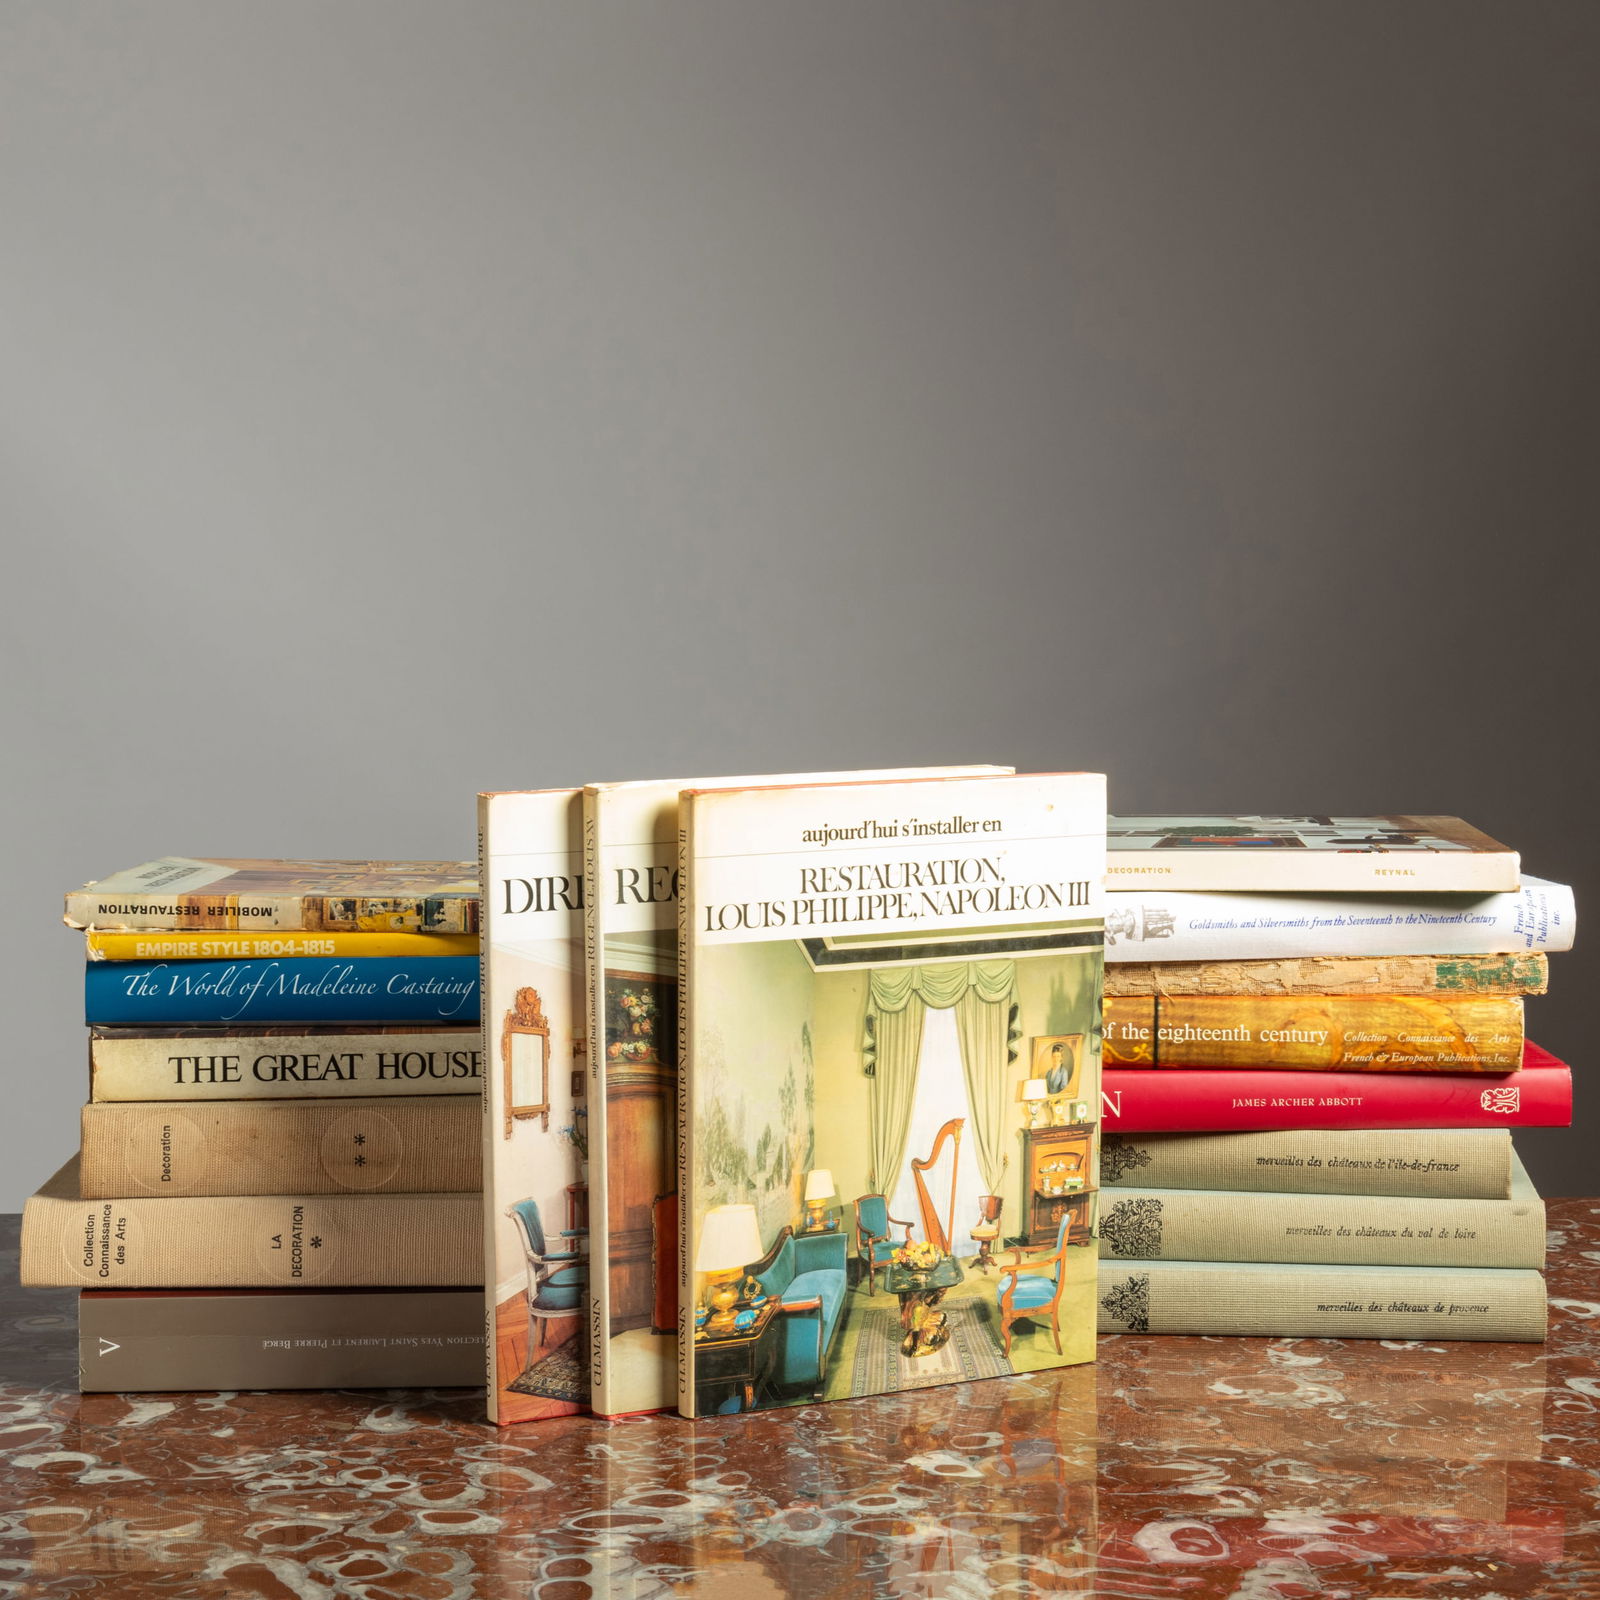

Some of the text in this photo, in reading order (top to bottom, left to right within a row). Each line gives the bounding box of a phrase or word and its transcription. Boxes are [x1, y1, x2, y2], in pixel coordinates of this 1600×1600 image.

[802, 816, 1003, 847] aujourd'hui s'installer en
[586, 838, 594, 883] LOUIS
[799, 857, 1006, 894] RESTAURATION,
[98, 903, 273, 917] MOBILIER RESTAURATION
[704, 902, 786, 932] LOUIS
[1068, 881, 1091, 907] III
[1188, 913, 1498, 929] Goldsmiths and Silversmiths from the Seventeenth to the Nineteenth Century
[1513, 904, 1523, 934] French
[135, 939, 336, 957] EMPIRE STYLE 1804-1815
[1524, 933, 1533, 948] and
[590, 964, 596, 977] en
[123, 963, 476, 1020] The World of Madeleine Castaing
[1121, 1022, 1150, 1040] the
[1157, 1023, 1251, 1043] eighteenth
[1259, 1028, 1329, 1046] century
[1343, 1032, 1511, 1043] Collection Connaissance des Arts
[168, 1055, 242, 1084] THE
[252, 1052, 364, 1083] GREAT
[1343, 1052, 1375, 1063] French
[1376, 1053, 1390, 1062] &
[1391, 1052, 1435, 1064] European
[1493, 1053, 1511, 1063] Inc.
[1232, 1097, 1363, 1109] JAMES ARCHER ABBOTT
[161, 1124, 171, 1182] Decoration
[1256, 1155, 1304, 1167] merveilles
[1307, 1156, 1322, 1167] des
[1374, 1158, 1385, 1169] de
[681, 1174, 686, 1186] en
[83, 1213, 95, 1267] Collection
[99, 1203, 112, 1278] Connaissance
[115, 1217, 127, 1265] des Arts
[271, 1233, 282, 1250] LA
[292, 1205, 304, 1278] DECORATION
[1285, 1225, 1476, 1239] merveilles des châteaux du val de loire
[1316, 1301, 1363, 1312] merveilles
[1368, 1302, 1383, 1312] des
[1387, 1302, 1430, 1313] châteaux
[1433, 1302, 1445, 1312] de
